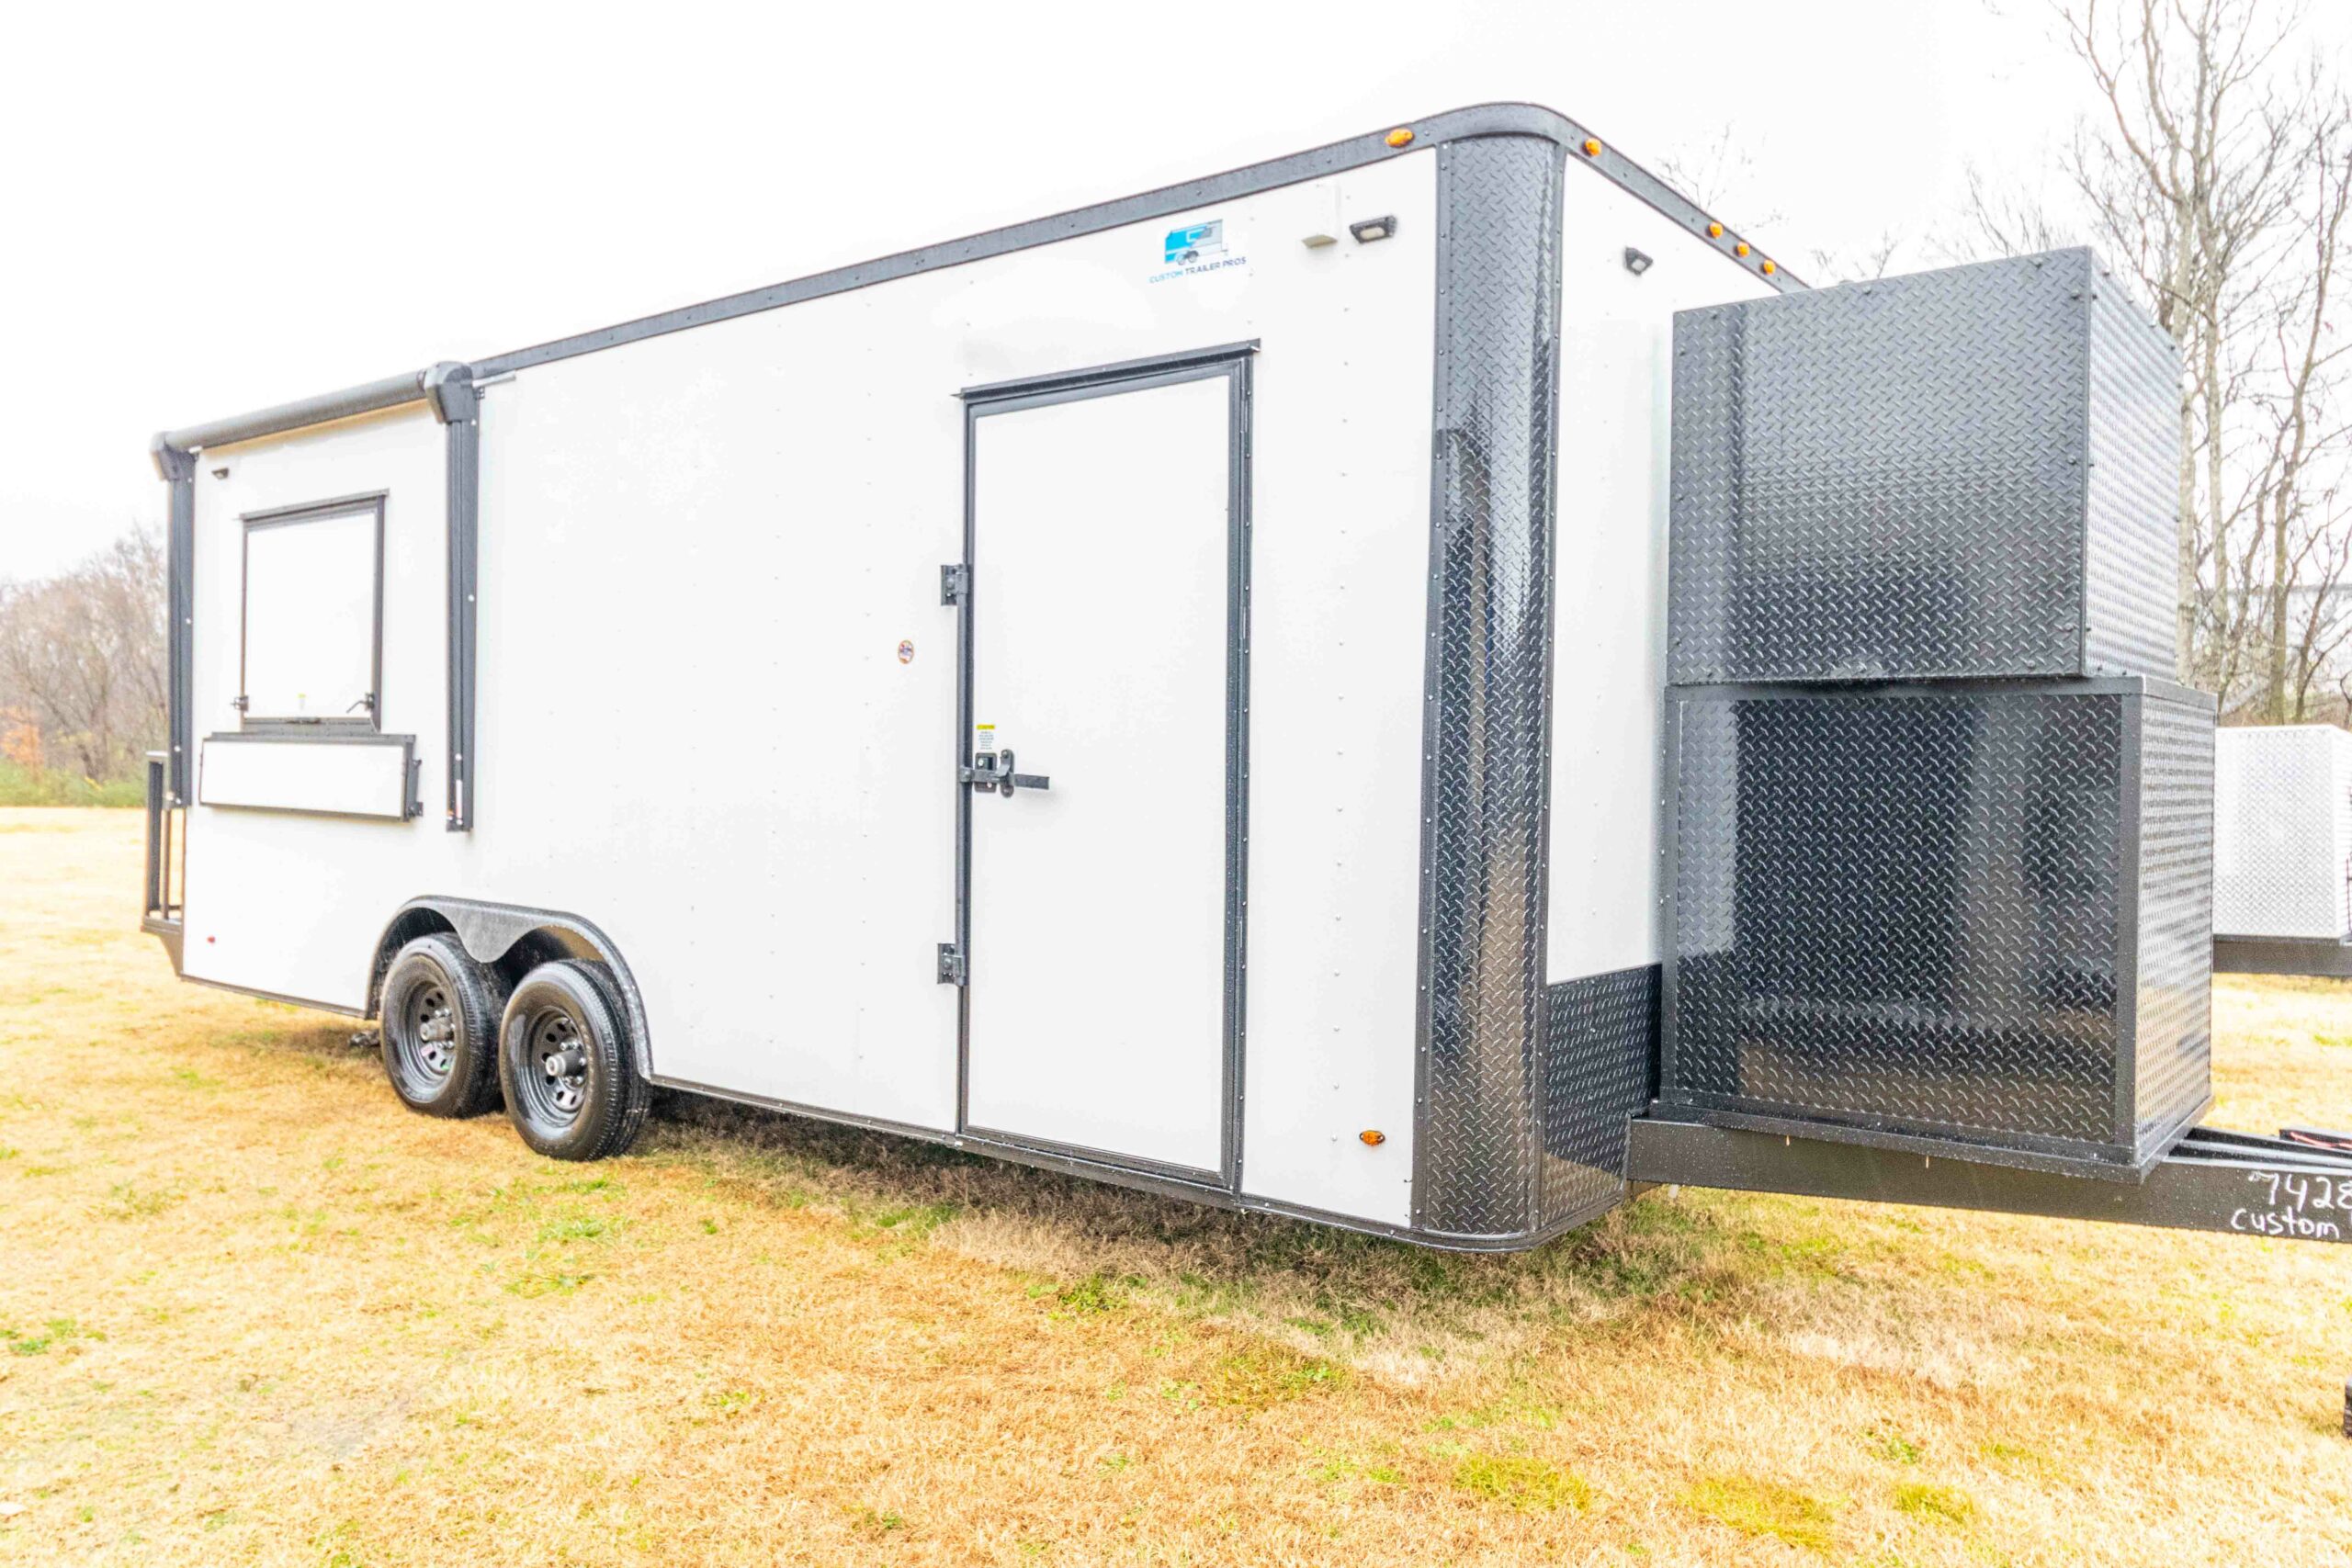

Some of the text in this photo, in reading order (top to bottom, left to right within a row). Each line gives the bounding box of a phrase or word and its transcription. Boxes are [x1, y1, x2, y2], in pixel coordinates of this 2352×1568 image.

[1149, 256, 1247, 283] CUSTOM TRAILER PROS
[2248, 1171, 2352, 1212] 7428
